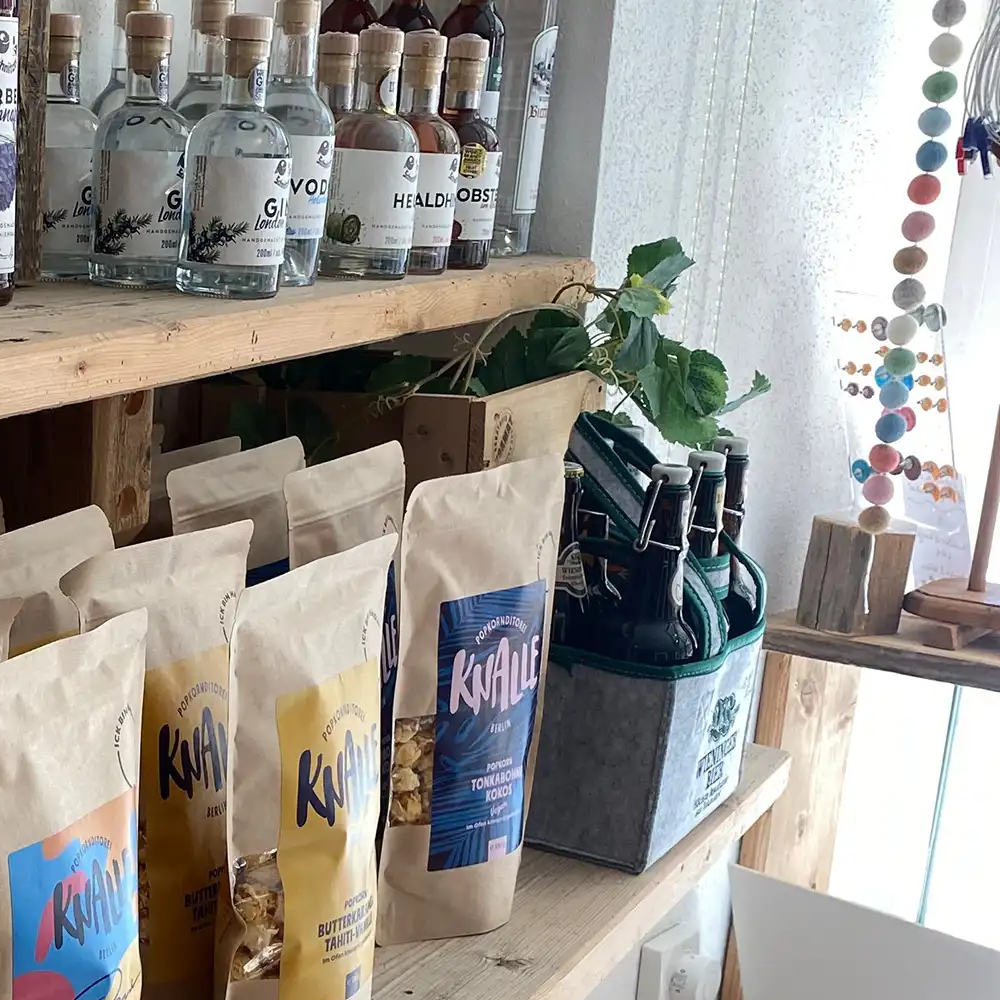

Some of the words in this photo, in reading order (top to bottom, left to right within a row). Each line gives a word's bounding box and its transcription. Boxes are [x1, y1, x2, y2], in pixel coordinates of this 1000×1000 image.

[264, 197, 286, 218] GI
[474, 615, 528, 645] POPKORNDITOREI
[449, 634, 540, 716] KNALLE
[113, 724, 122, 748] ICK
[489, 718, 512, 734] BERLIN
[296, 722, 379, 828] KNALLE
[486, 759, 513, 773] POPKORN
[485, 785, 513, 803] KOKOS
